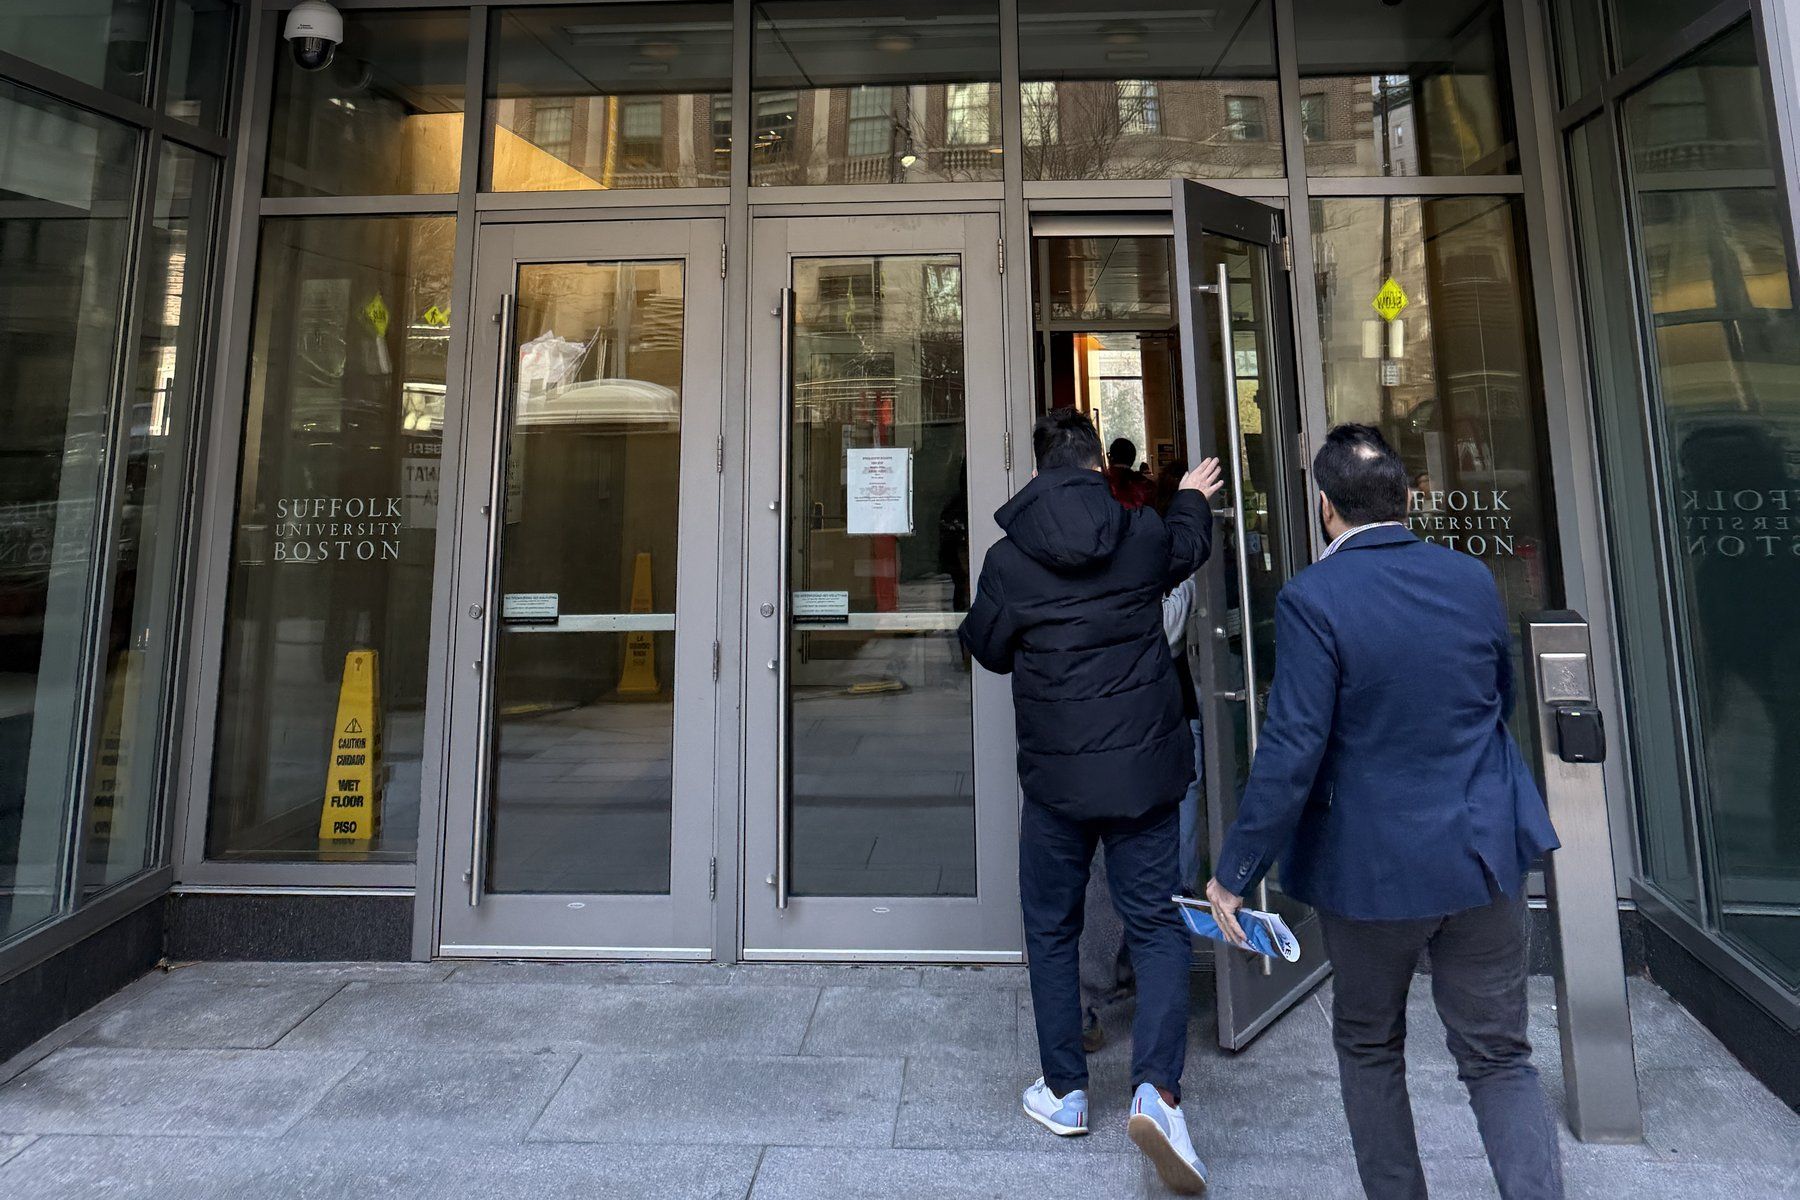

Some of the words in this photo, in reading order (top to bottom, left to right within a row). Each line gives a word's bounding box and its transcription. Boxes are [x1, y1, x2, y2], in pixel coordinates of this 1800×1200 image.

[276, 497, 402, 518] SUFFOLK
[1411, 490, 1511, 511] FFOLK
[276, 522, 402, 537] UNIVERSITY
[1408, 516, 1512, 530] IVERSITY
[274, 540, 400, 561] BOSTON
[338, 738, 366, 749] CAUTION
[338, 779, 360, 792] WET
[330, 795, 364, 808] FLOOR
[333, 821, 357, 834] PISO
